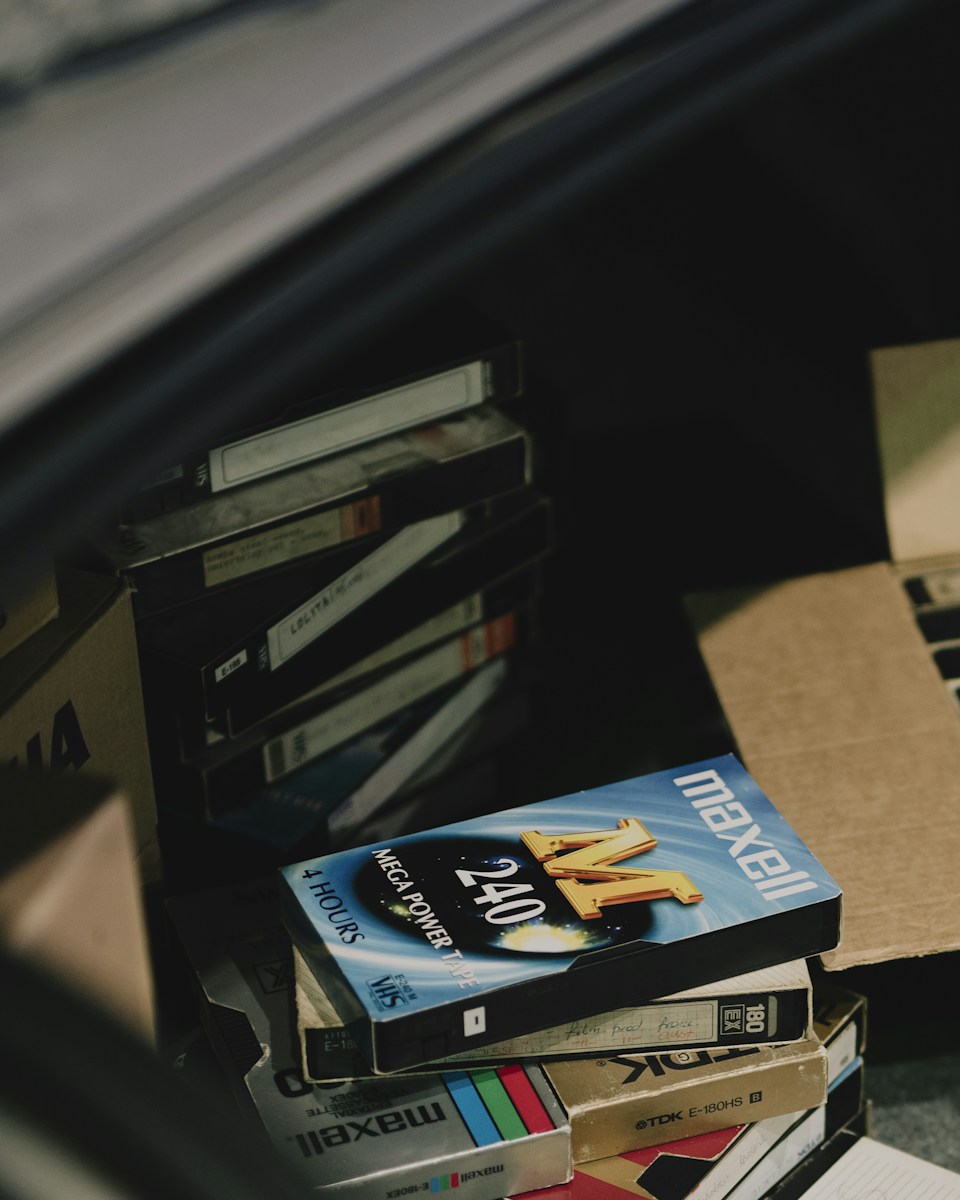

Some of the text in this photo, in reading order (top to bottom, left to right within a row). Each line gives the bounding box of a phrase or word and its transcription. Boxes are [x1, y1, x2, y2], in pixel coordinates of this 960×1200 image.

[672, 768, 819, 902] maxell
[454, 858, 547, 926] 240
[519, 817, 704, 921] M
[302, 868, 366, 945] 4 HOURS
[371, 848, 481, 991] MEGA POWER TAPE
[370, 975, 406, 1009] VHS
[723, 1008, 742, 1031] EX
[745, 1003, 766, 1034] 180
[294, 1101, 447, 1158] maxell
[647, 1110, 683, 1127] TDK
[689, 1097, 743, 1118] E-180HS
[385, 1163, 505, 1200] maxell E-180EX
